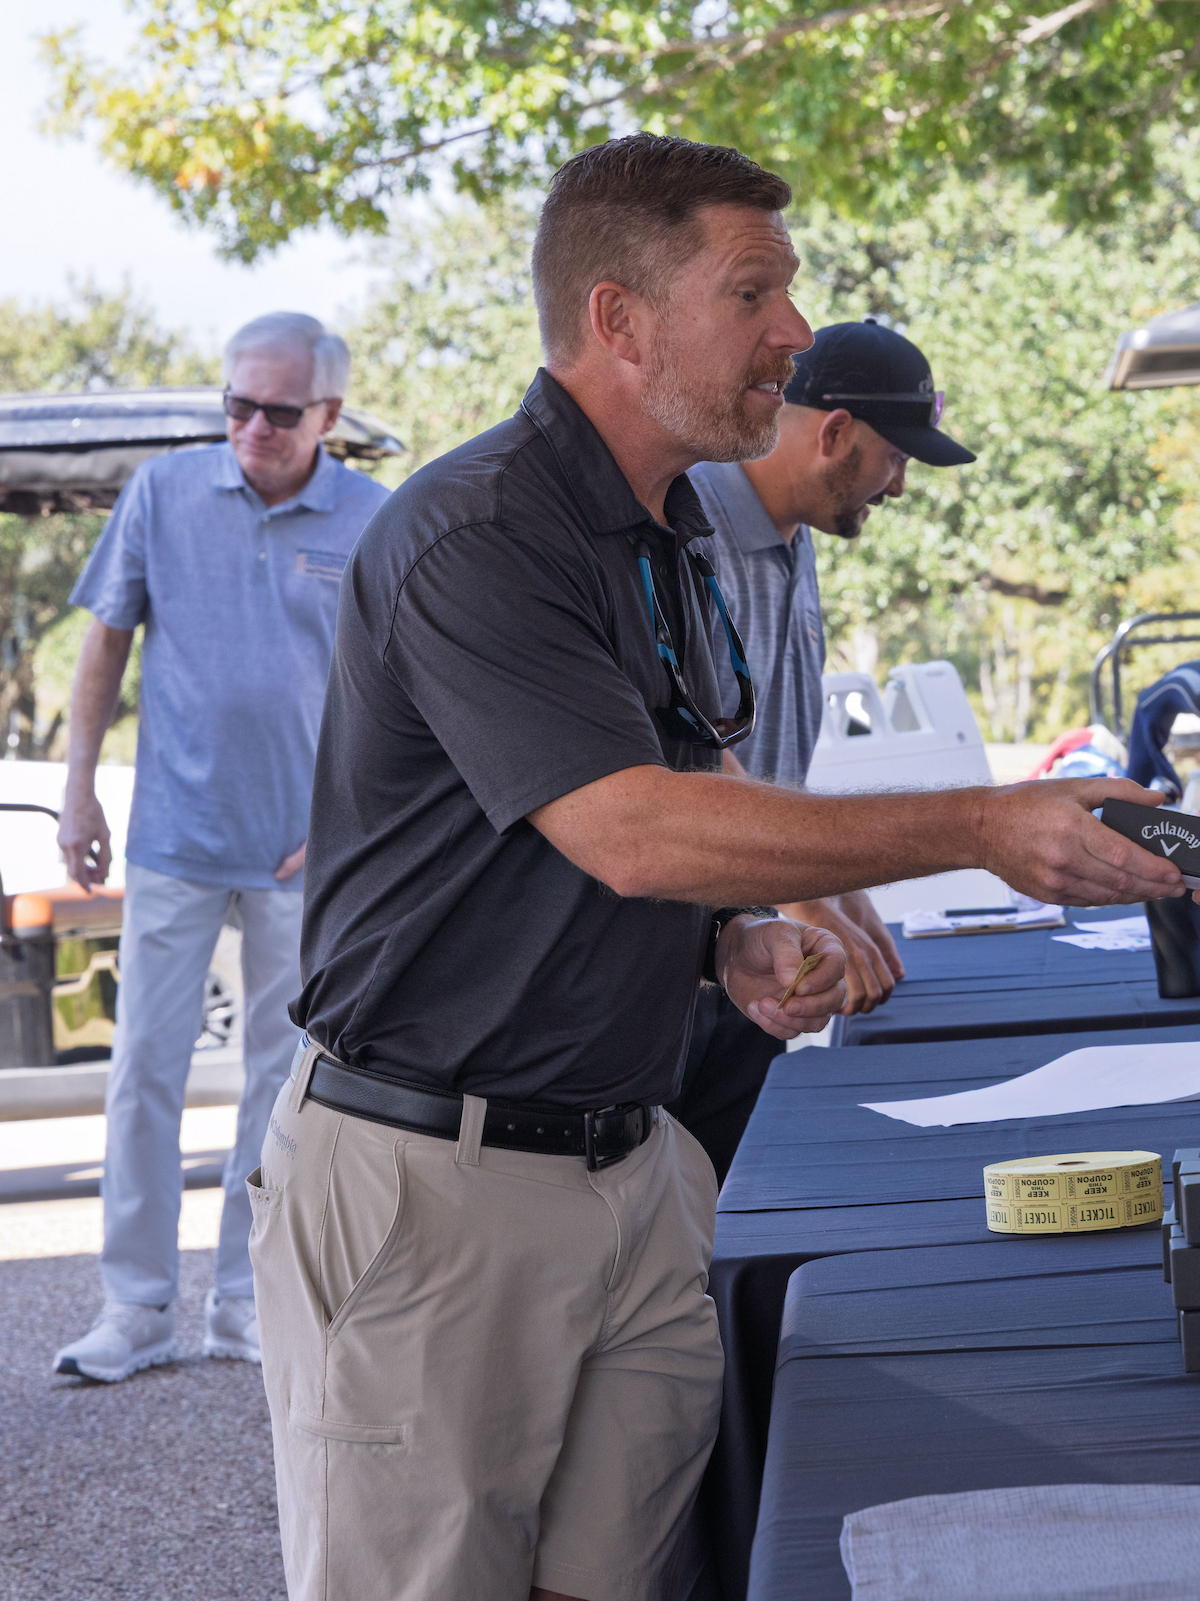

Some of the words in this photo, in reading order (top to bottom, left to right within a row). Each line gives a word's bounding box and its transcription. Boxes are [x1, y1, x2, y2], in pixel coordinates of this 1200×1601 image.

[1141, 821, 1200, 849] Callaway
[1131, 1167, 1154, 1178] COUPON
[1021, 1178, 1055, 1186] COUPON
[1077, 1174, 1113, 1184] COUPON
[1136, 1180, 1152, 1189] KEEP
[1027, 1190, 1050, 1198] KEEP
[1084, 1186, 1108, 1195] KEEP
[1134, 1200, 1156, 1216] TICKET
[1024, 1211, 1058, 1224] TICKET
[1080, 1207, 1115, 1222] TICKET
